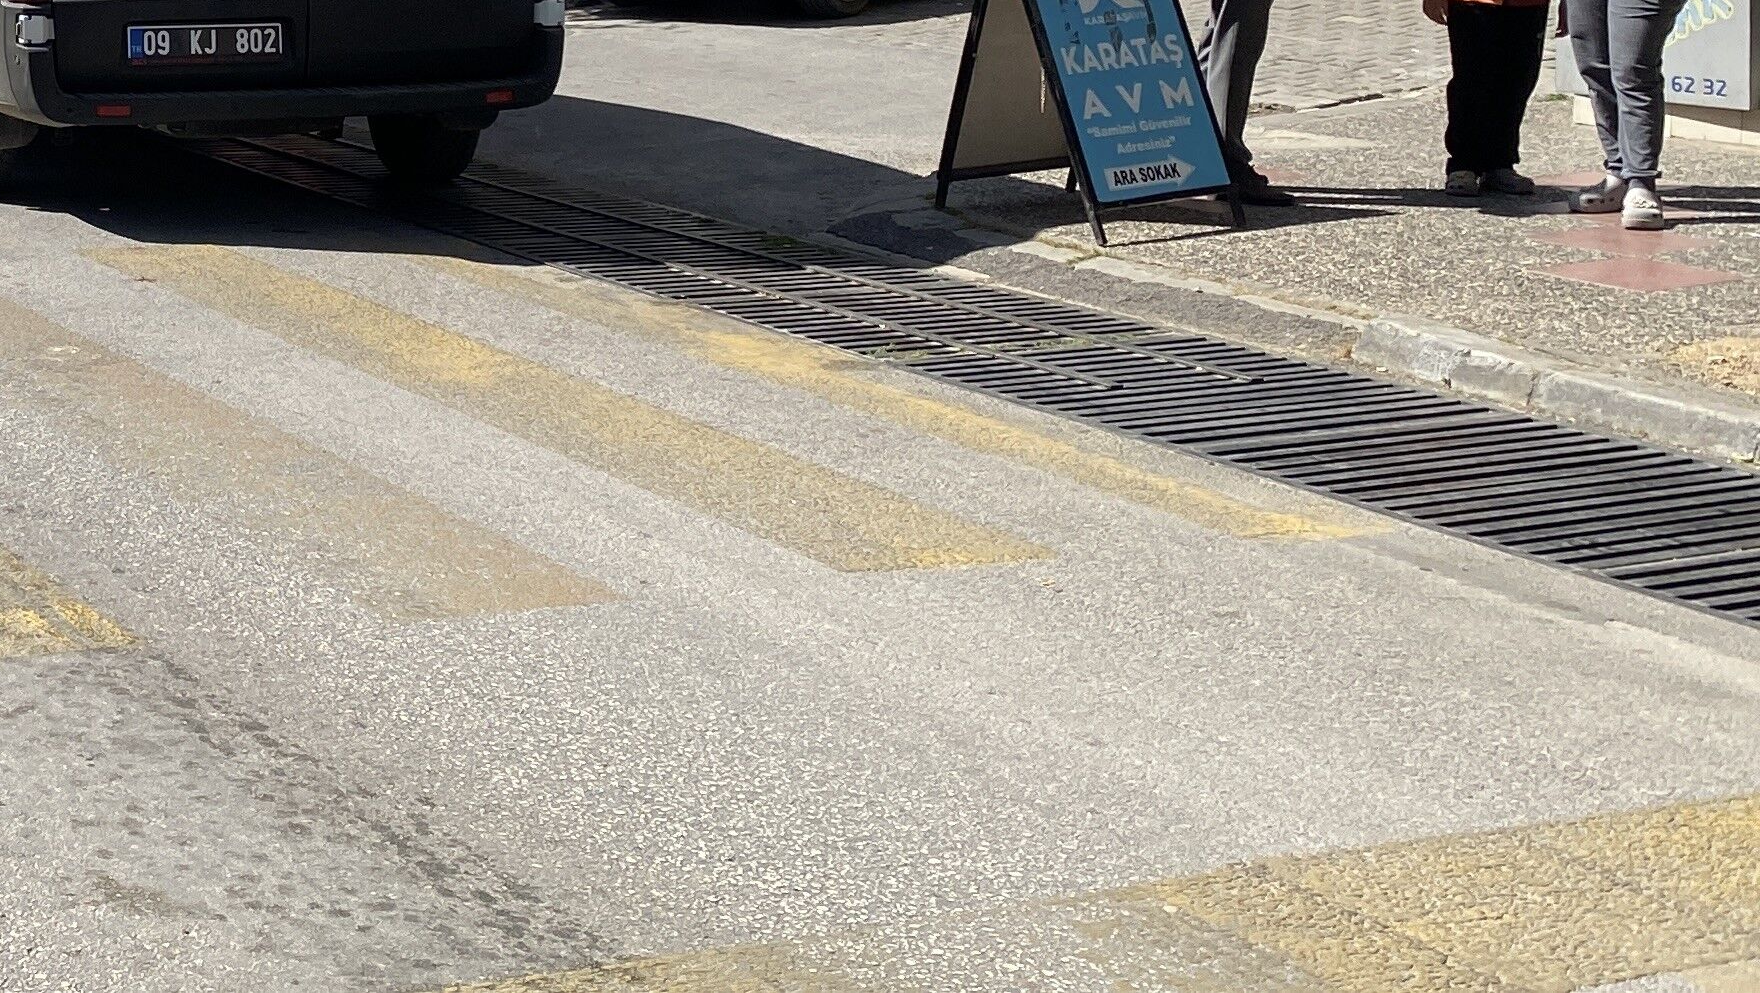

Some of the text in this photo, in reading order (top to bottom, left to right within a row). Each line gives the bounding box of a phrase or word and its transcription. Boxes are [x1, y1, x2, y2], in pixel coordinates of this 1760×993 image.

[143, 30, 171, 56] 09
[190, 29, 218, 55] KJ
[235, 28, 277, 54] 802
[1060, 34, 1184, 76] KARATAŞ
[1671, 75, 1728, 98] 62 32
[1113, 162, 1182, 187] ARA SOKAK
